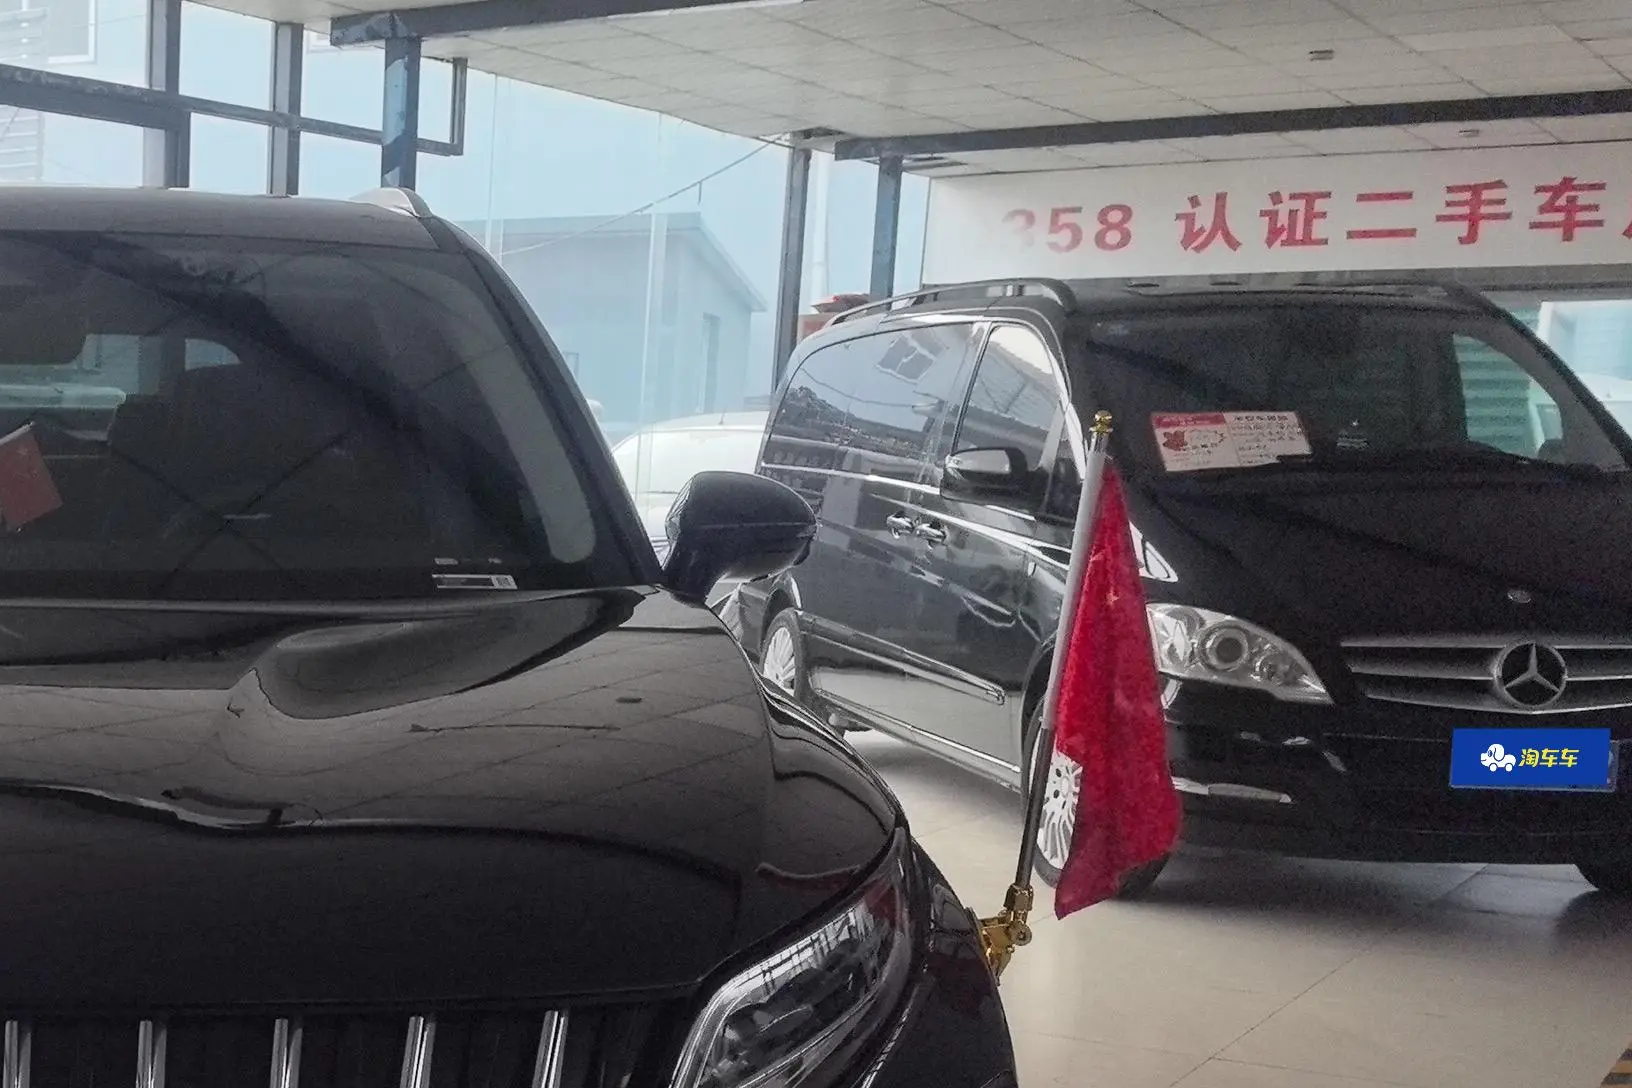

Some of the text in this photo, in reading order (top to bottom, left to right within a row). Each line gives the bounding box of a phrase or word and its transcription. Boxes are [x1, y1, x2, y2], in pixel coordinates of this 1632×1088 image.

[1174, 176, 1632, 253] 认证二手车
